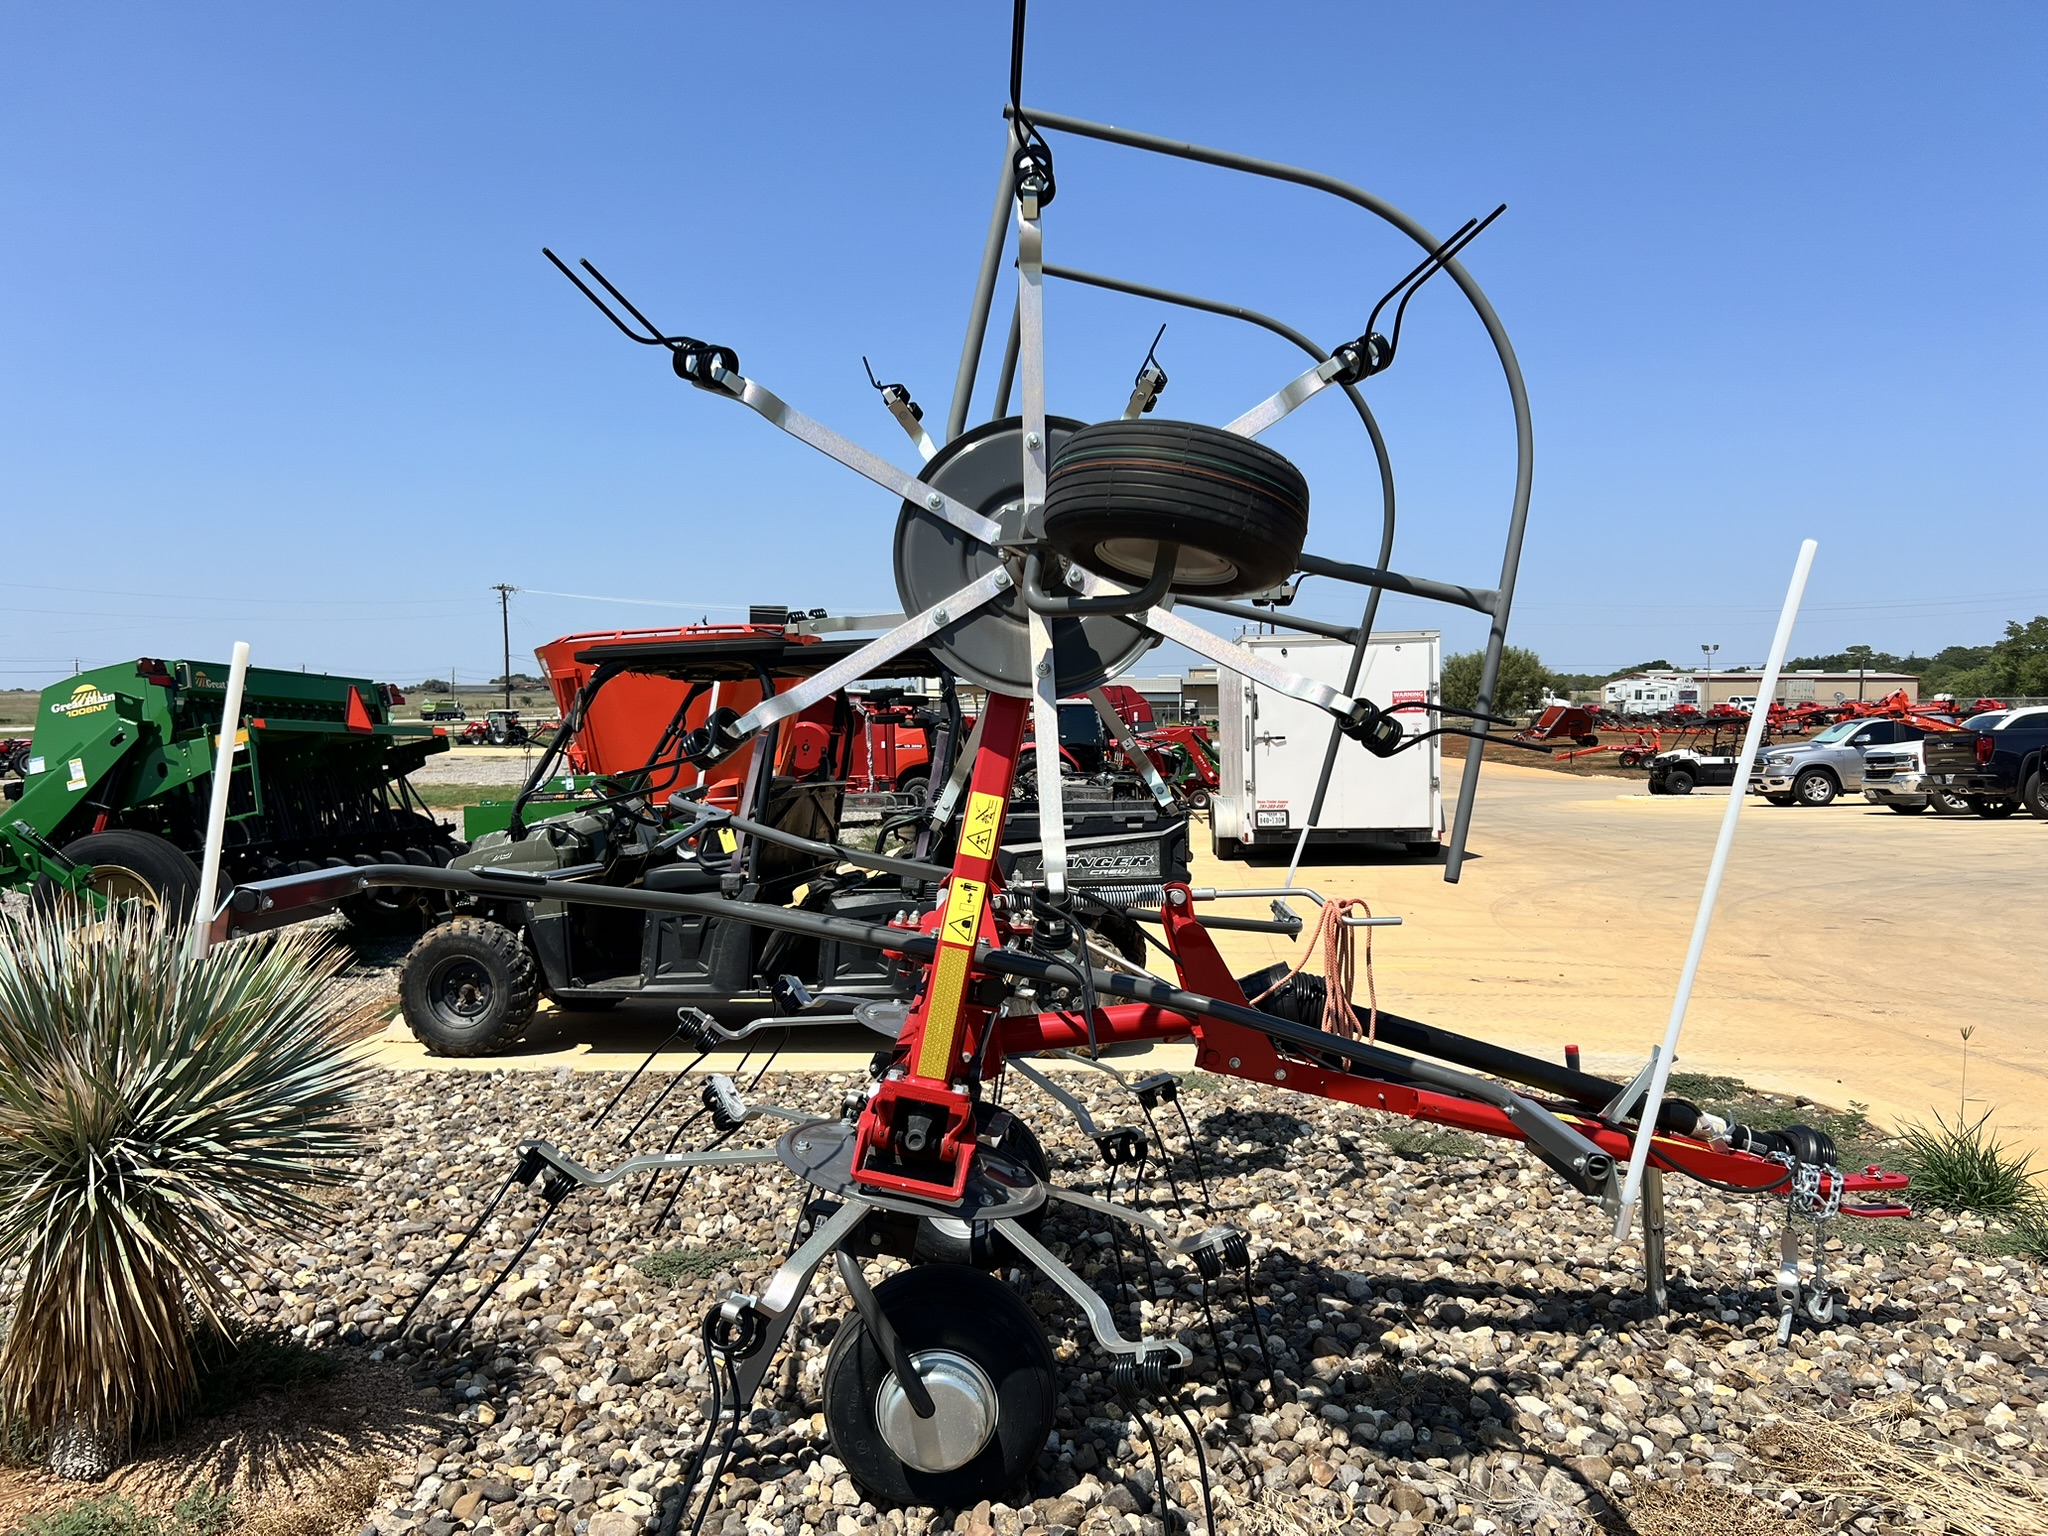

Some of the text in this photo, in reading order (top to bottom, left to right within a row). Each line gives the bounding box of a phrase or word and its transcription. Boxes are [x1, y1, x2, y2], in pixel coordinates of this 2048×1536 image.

[205, 679, 226, 690] Great
[50, 692, 116, 714] Great Plain
[65, 703, 109, 718] 1006NT
[1036, 854, 1154, 870] ANGER
